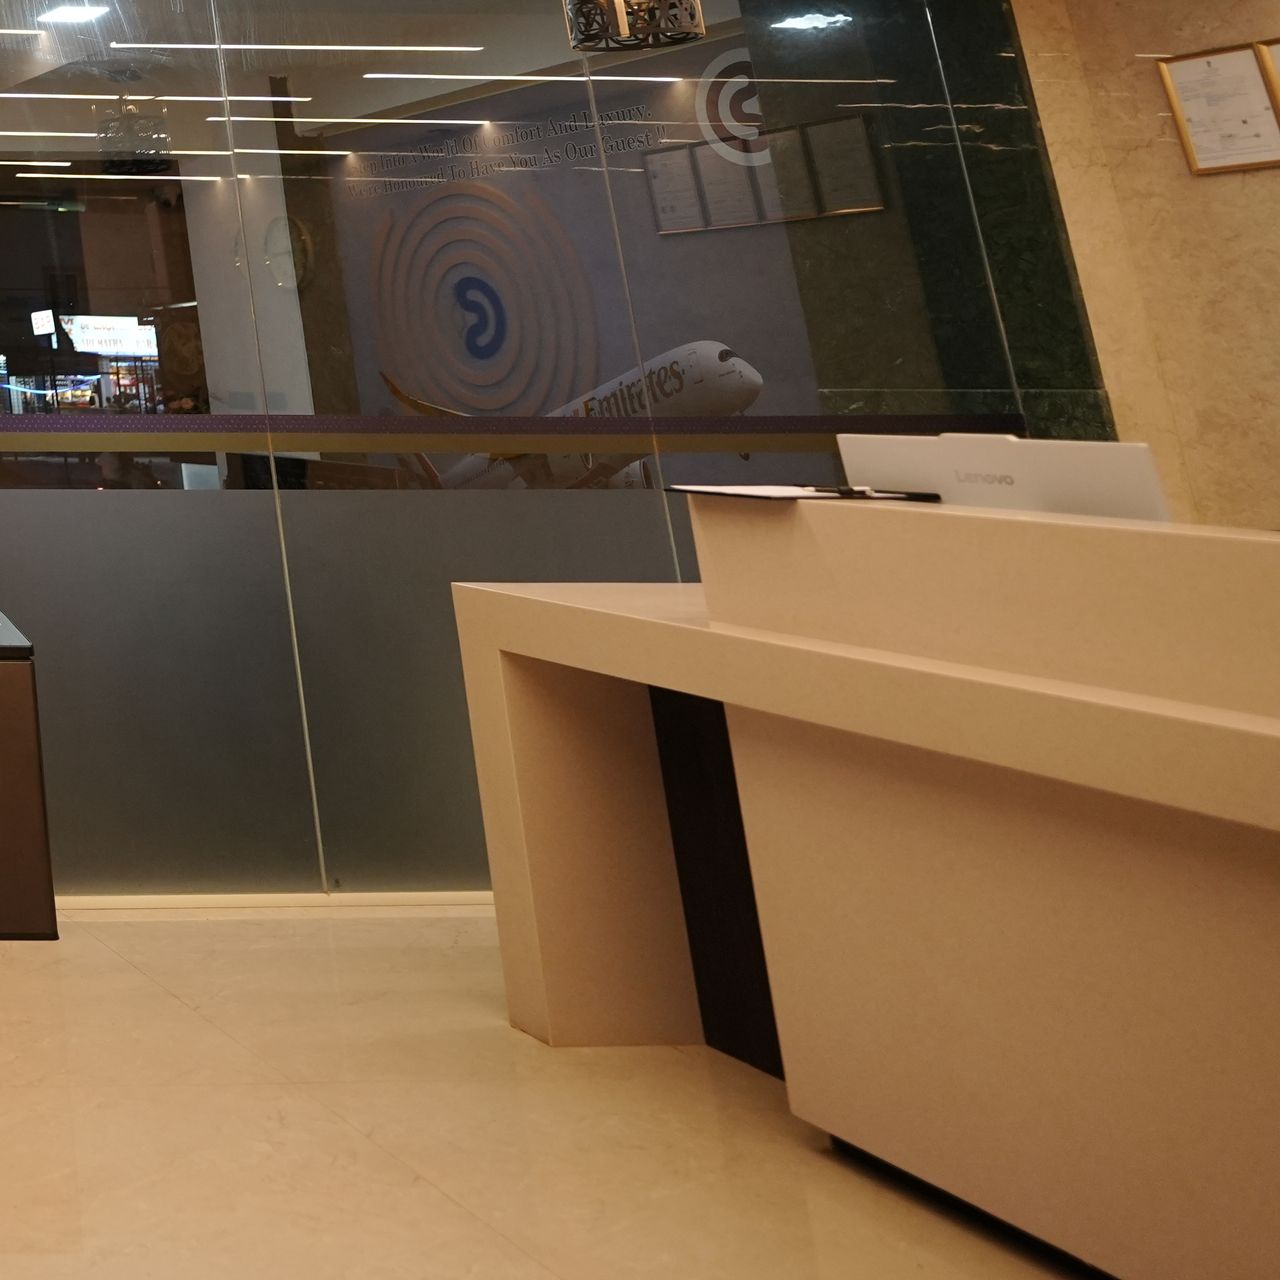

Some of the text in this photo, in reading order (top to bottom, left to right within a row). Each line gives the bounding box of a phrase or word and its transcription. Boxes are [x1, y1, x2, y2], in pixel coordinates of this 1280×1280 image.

[380, 154, 405, 171] Into
[419, 137, 457, 161] World
[462, 132, 480, 153] Of
[482, 124, 542, 150] Comfort
[547, 112, 578, 137] And
[384, 167, 446, 193] Honoured
[447, 164, 467, 181] To
[469, 159, 505, 179] Have
[508, 152, 538, 169] You
[542, 148, 561, 166] As
[564, 140, 596, 161] Our
[600, 131, 652, 154] Guest
[584, 361, 680, 417] Emirates
